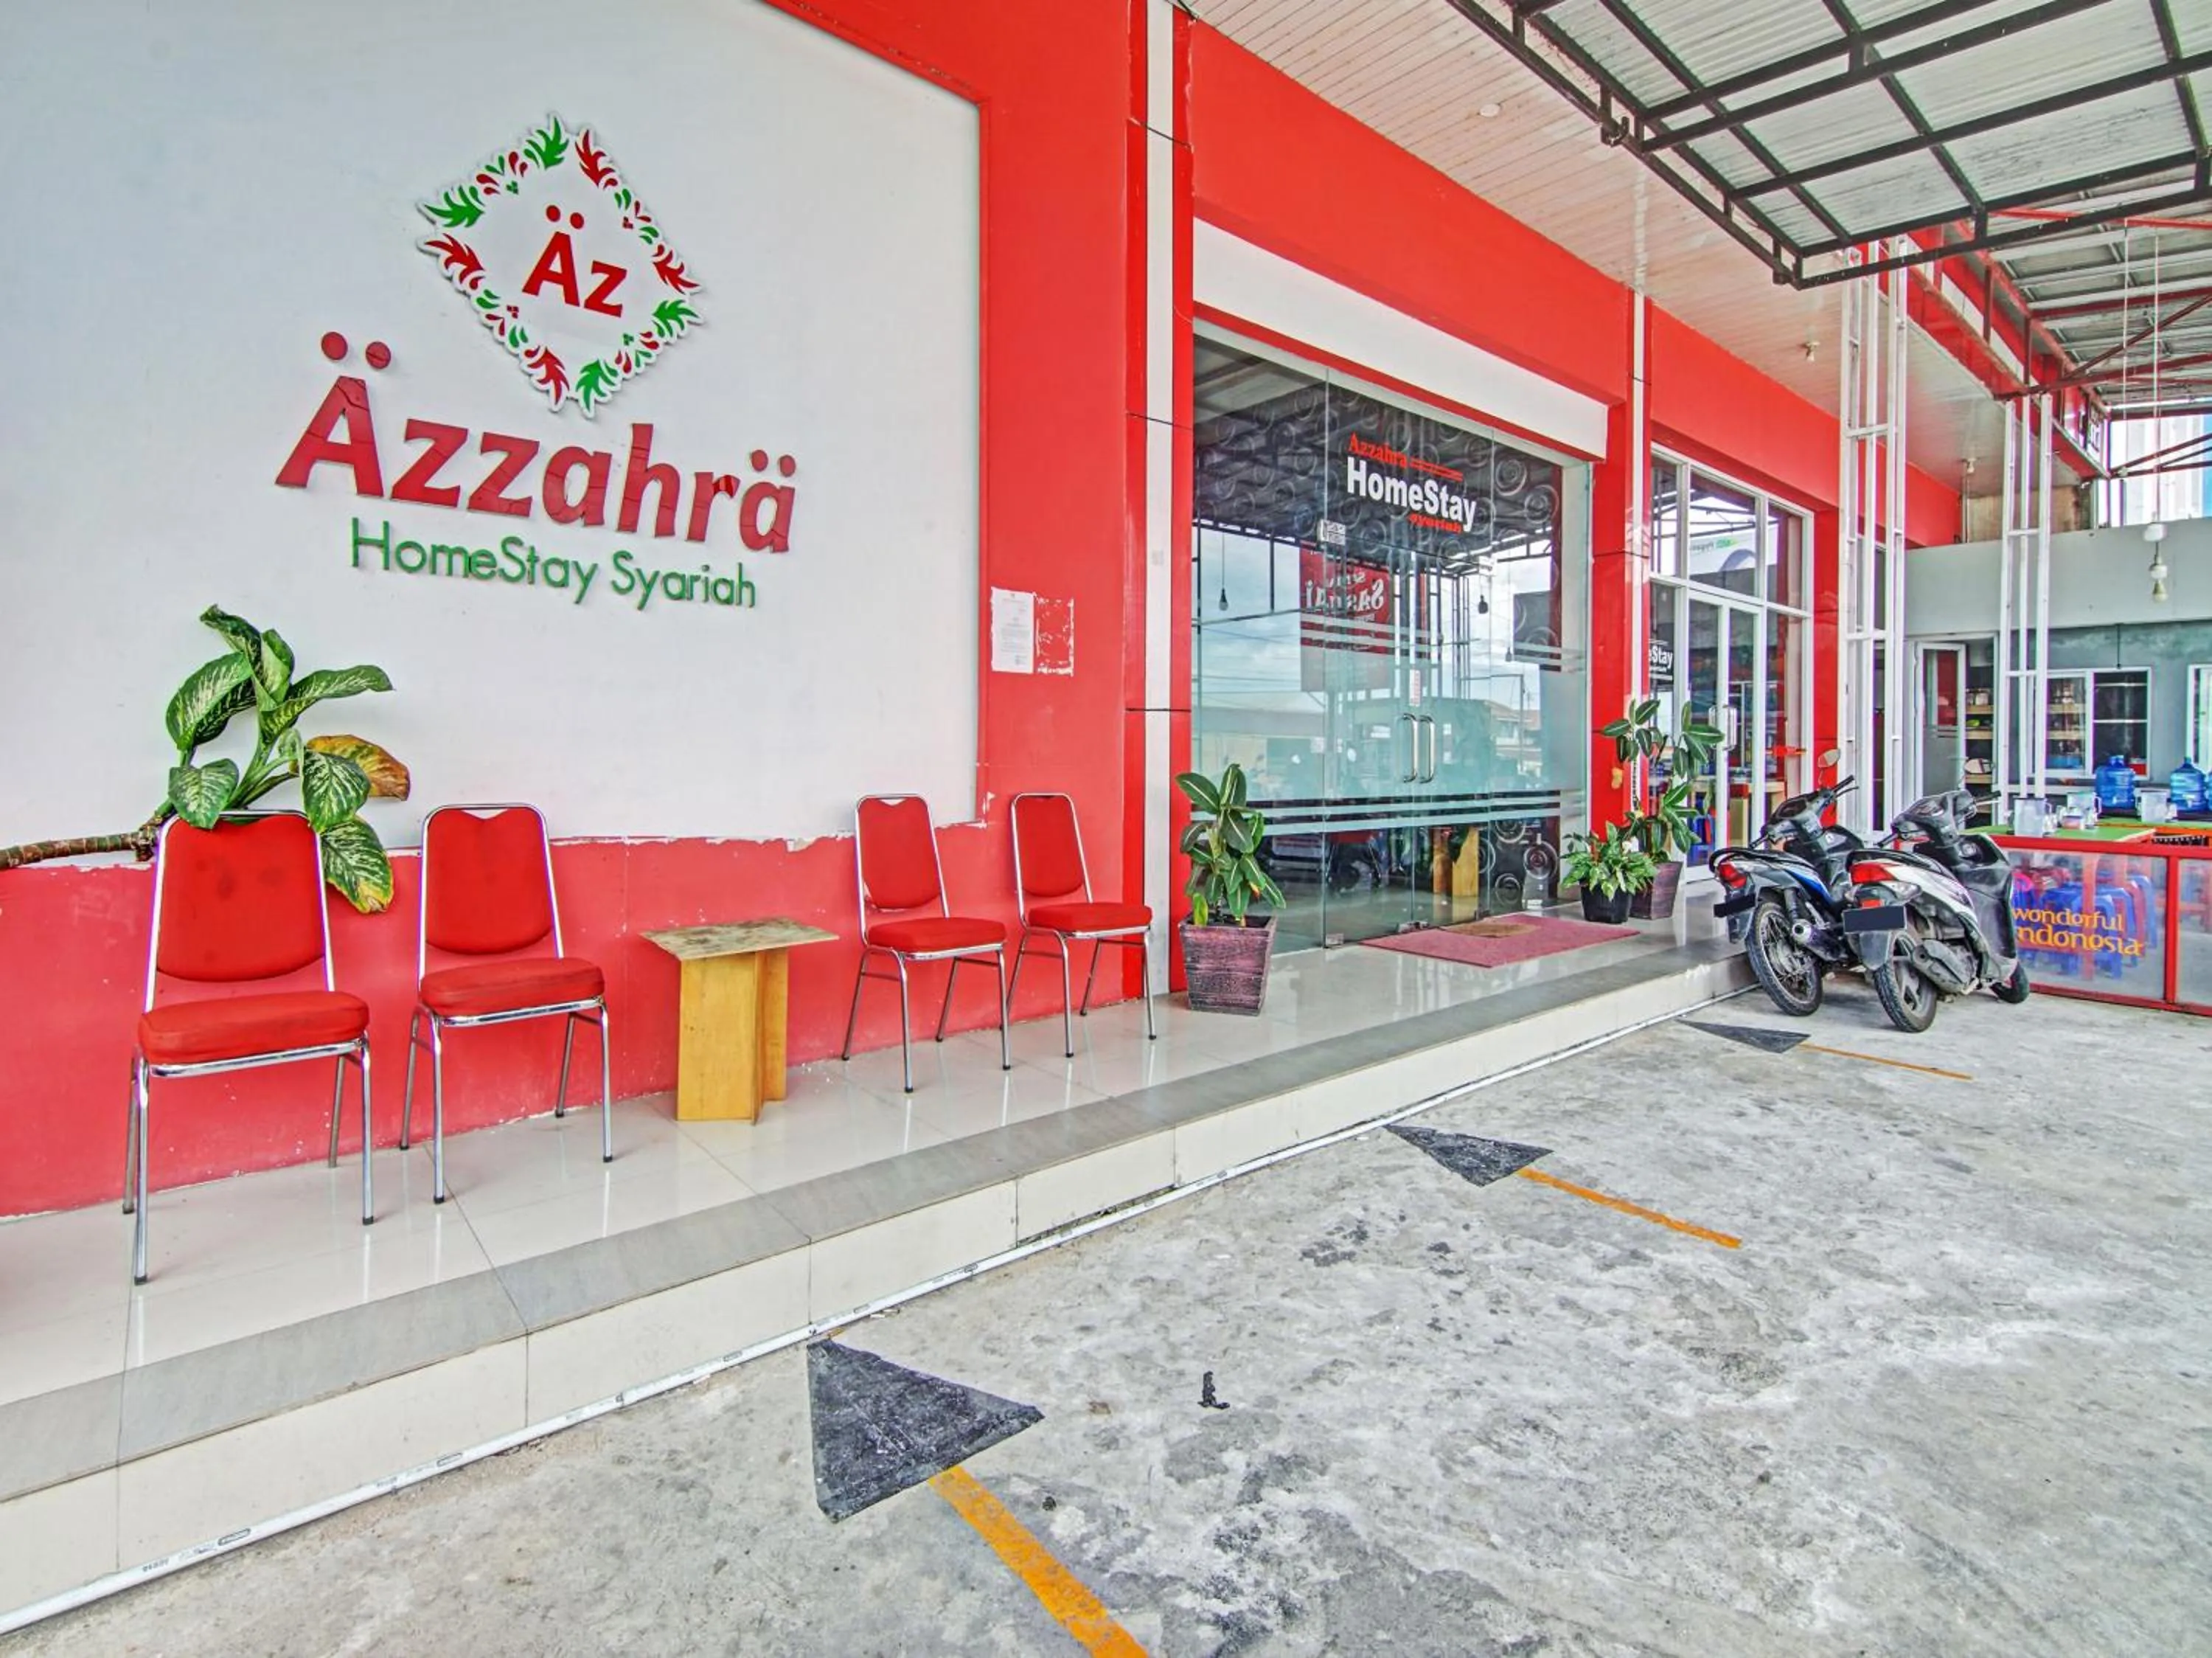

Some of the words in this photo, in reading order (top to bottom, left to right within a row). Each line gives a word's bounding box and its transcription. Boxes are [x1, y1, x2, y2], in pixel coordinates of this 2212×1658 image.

[1347, 457, 1477, 532] HomeStay
[351, 517, 599, 604] HomeStay
[611, 551, 757, 611] Syariah
[2016, 923, 2143, 956] ndonesia
